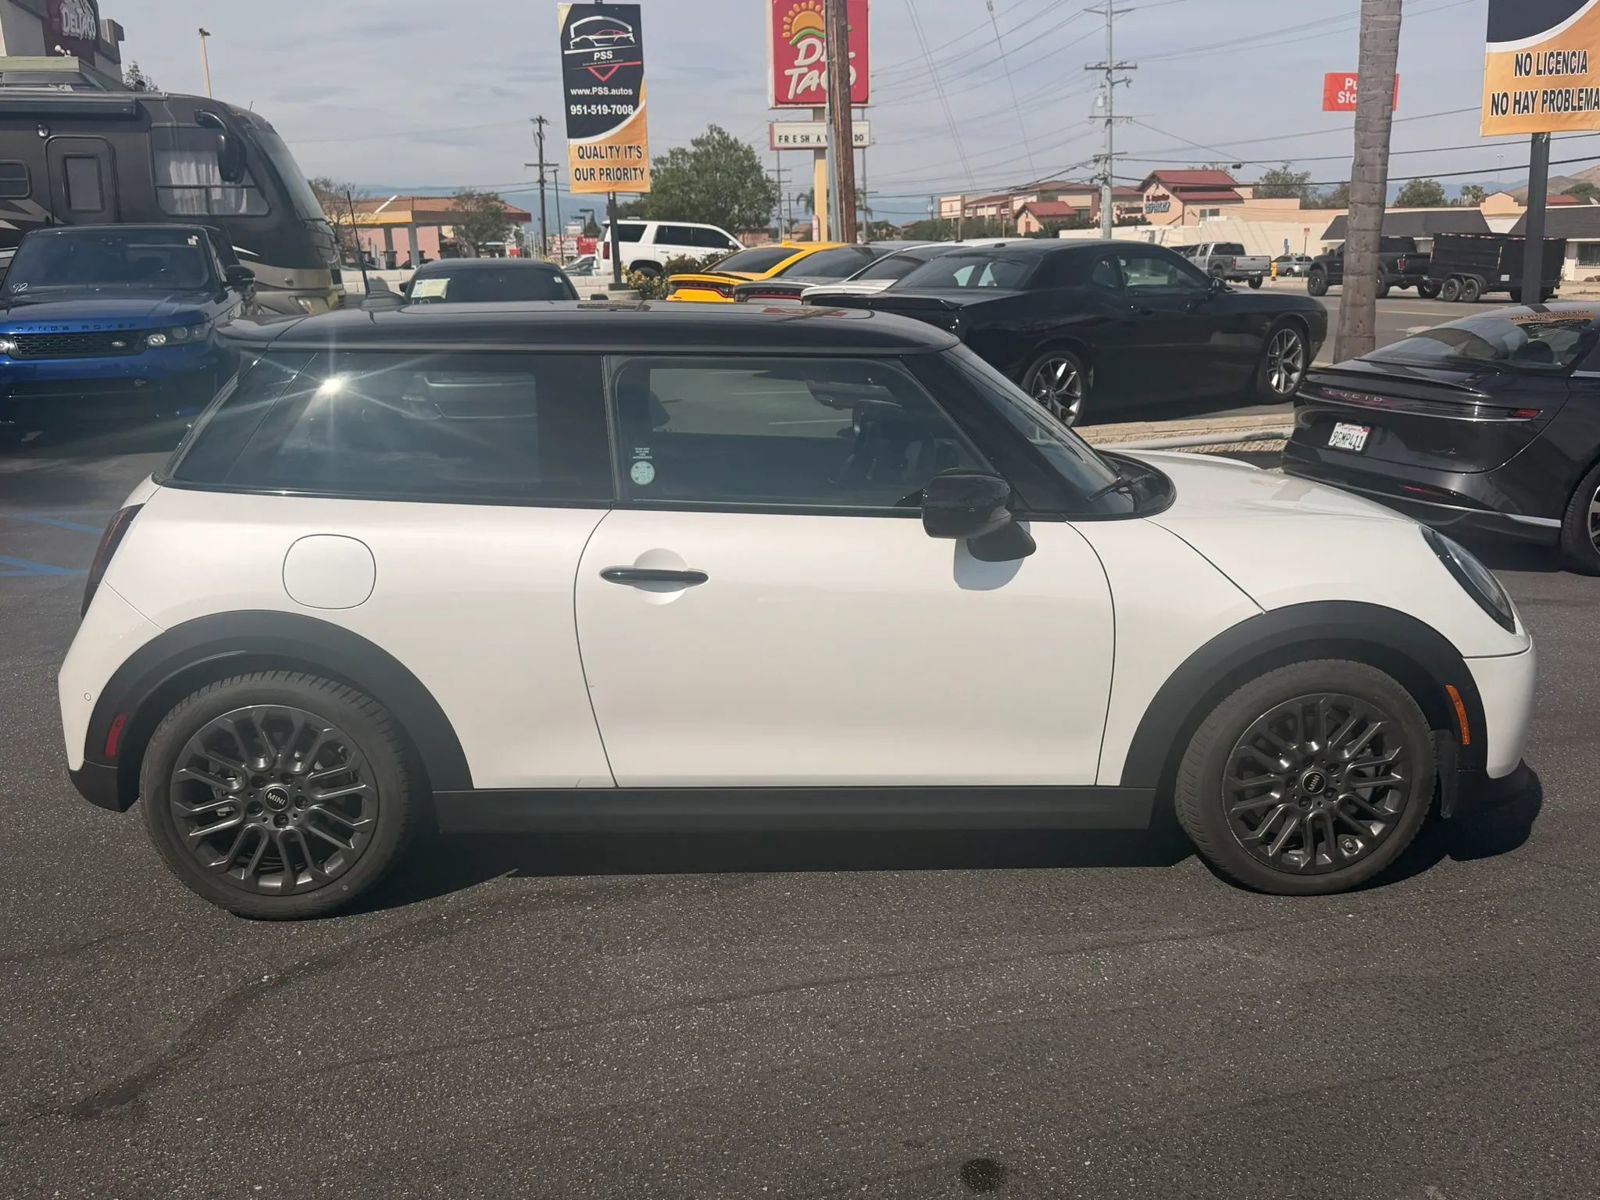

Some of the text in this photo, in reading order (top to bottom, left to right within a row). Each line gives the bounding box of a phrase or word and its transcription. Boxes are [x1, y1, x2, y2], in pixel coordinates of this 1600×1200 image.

[593, 51, 613, 60] PSS
[1514, 50, 1588, 77] NO LICENCIA
[570, 87, 633, 95] www.PSS.autos
[1490, 87, 1600, 116] NO HAY PROBLEMA
[570, 104, 634, 115] 951-519-7008
[778, 134, 810, 144] FRESH
[577, 145, 643, 160] QUALITY IT'S
[574, 167, 645, 181] OUR PRIORITY
[1328, 389, 1383, 402] LUCID
[267, 792, 286, 806] MINI
